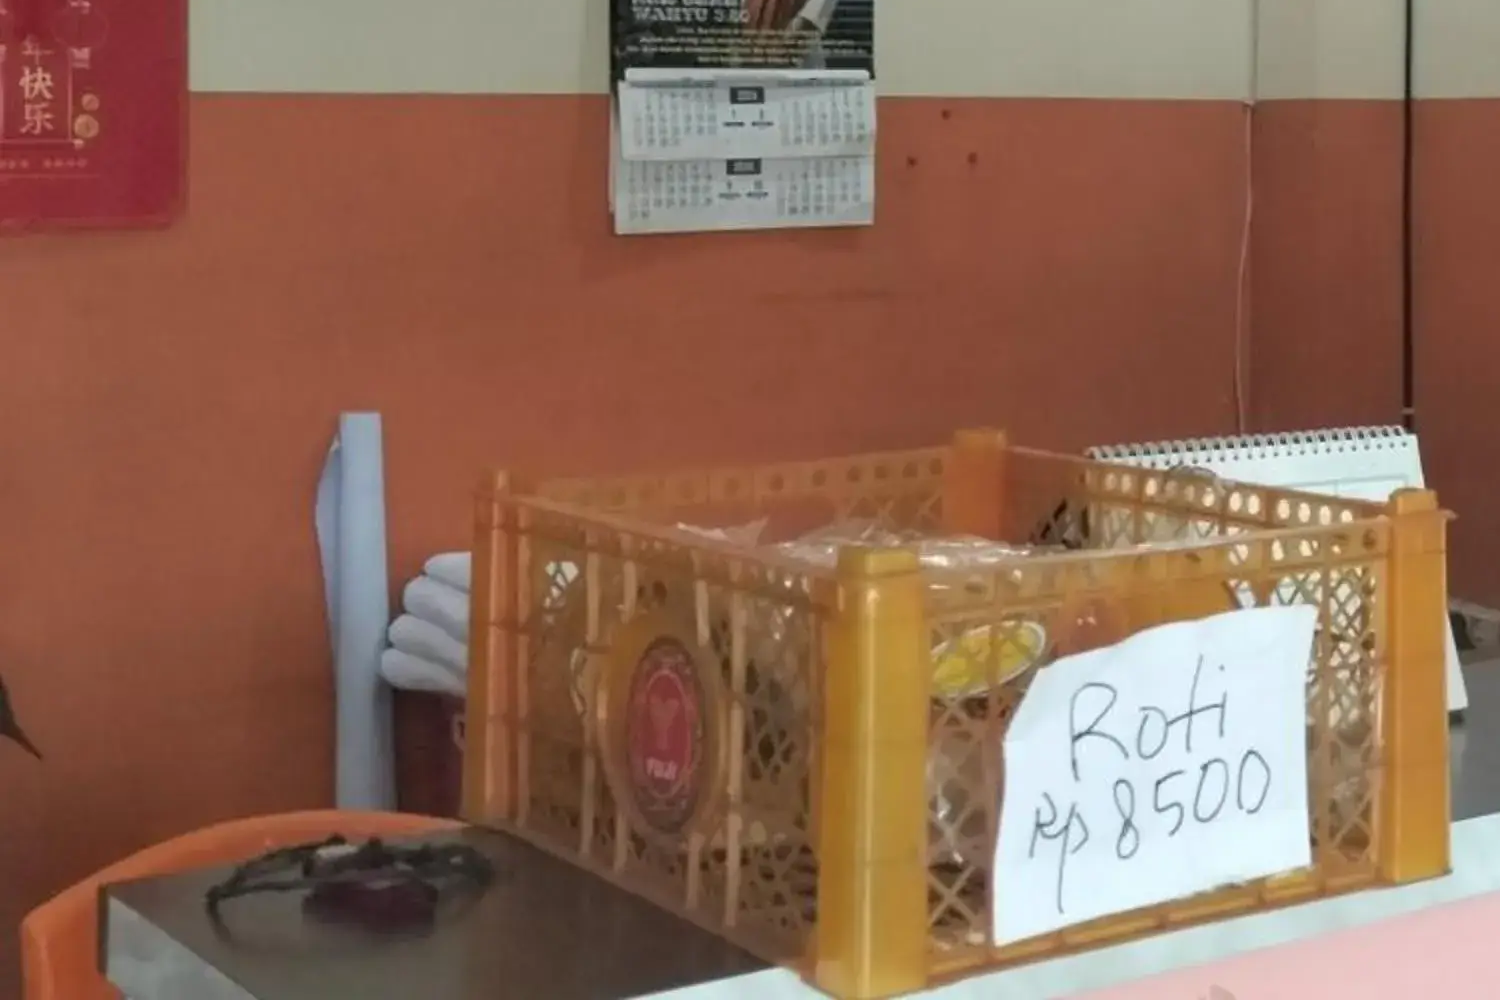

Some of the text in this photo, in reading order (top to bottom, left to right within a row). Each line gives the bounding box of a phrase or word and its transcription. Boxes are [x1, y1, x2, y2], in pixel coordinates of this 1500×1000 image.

[1069, 653, 1228, 782] Roti
[1028, 748, 1272, 914] Rp 8500
